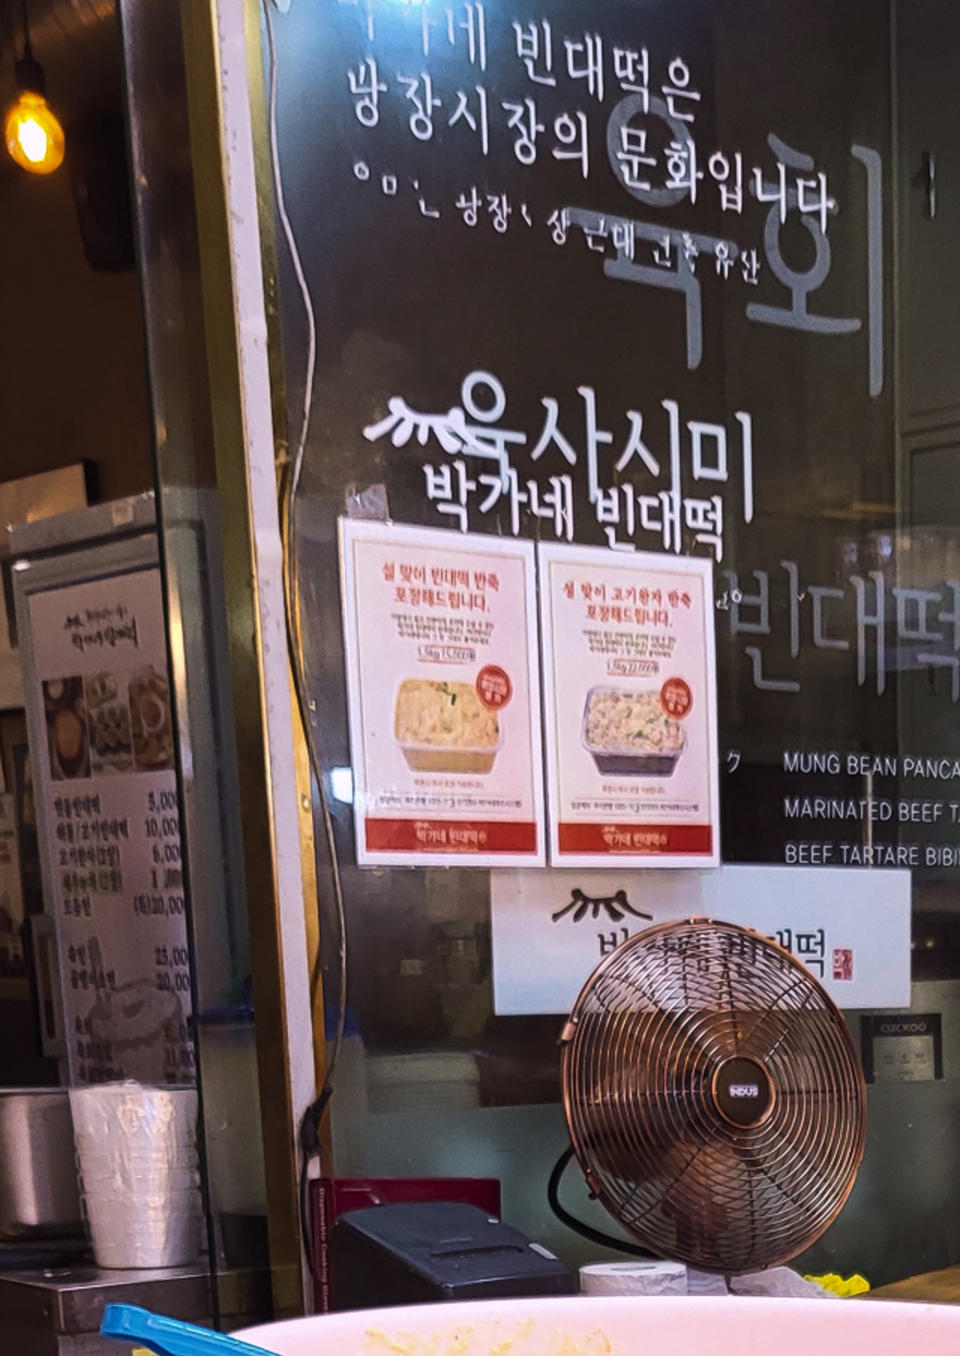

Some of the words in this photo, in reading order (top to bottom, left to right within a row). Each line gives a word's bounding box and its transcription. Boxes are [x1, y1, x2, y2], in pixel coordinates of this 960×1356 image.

[512, 18, 701, 122] 빈대떡은
[617, 124, 838, 235] 문화입니다
[461, 370, 754, 524] 육사시미
[422, 459, 573, 543] 박가네
[596, 482, 724, 564] 빈대떡
[784, 752, 841, 775] MUNG
[846, 755, 898, 778] BEAN
[784, 798, 893, 822] MARINATED
[898, 802, 943, 824] BEEF
[784, 844, 833, 865] BEEF
[840, 845, 920, 867] TARTARE
[880, 1022, 927, 1033] CUCKOO
